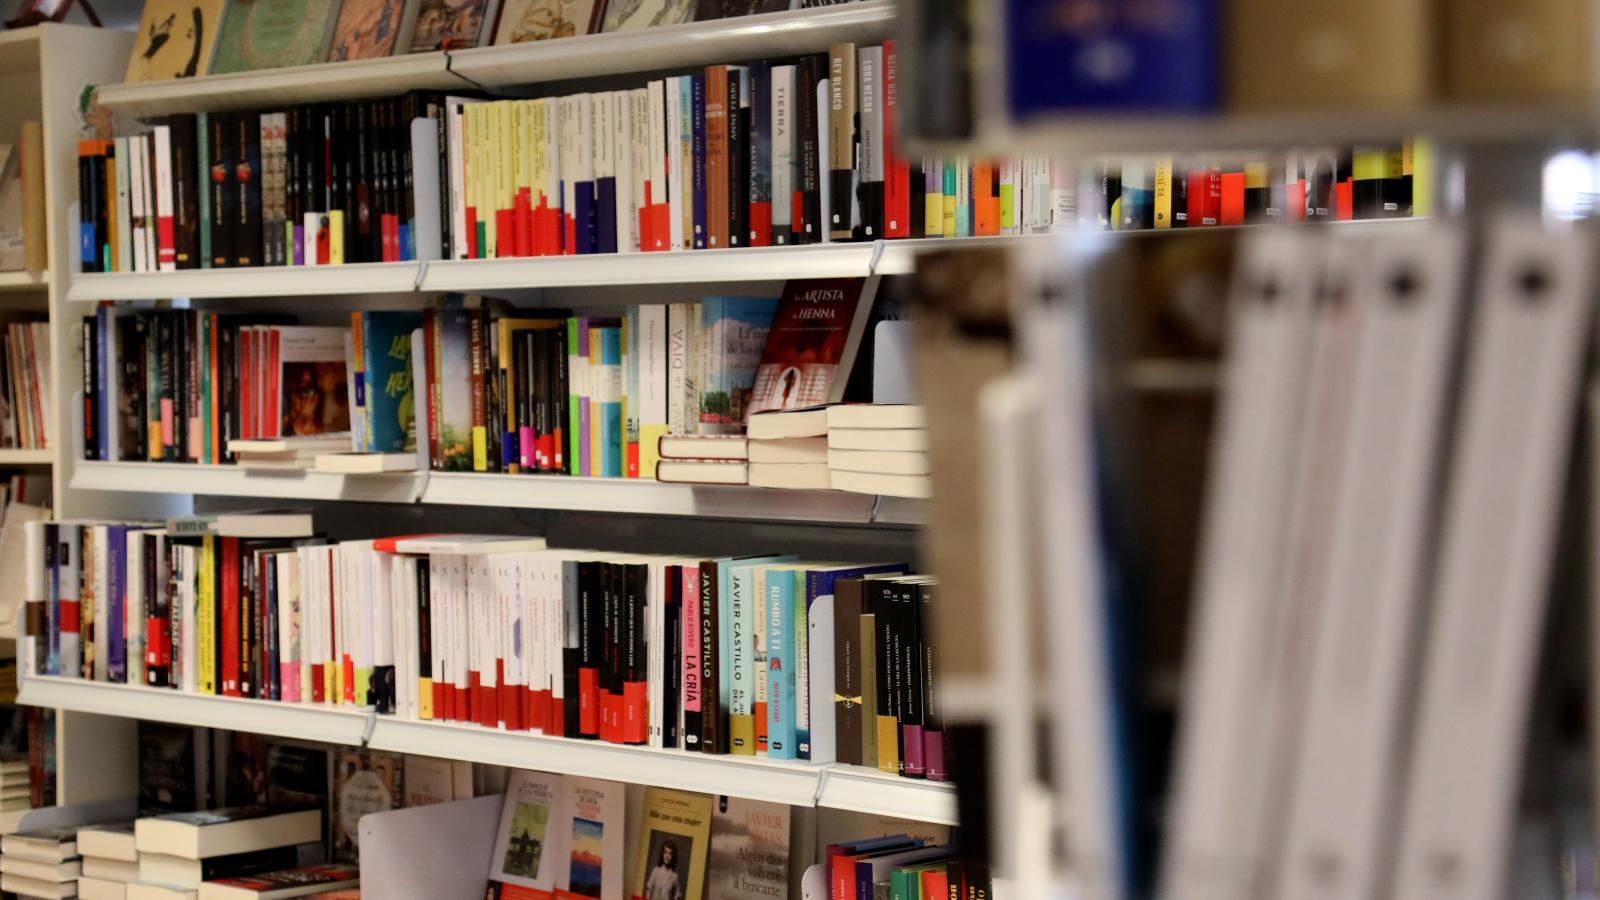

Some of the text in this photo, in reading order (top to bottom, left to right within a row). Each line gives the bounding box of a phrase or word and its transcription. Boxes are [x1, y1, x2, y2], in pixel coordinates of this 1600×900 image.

[729, 81, 737, 111] PERRY
[832, 57, 842, 110] REY BLANCO
[862, 60, 873, 113] LOBA NEGRA
[887, 55, 896, 106] REINA ROJA
[777, 86, 785, 136] TIERRA
[798, 308, 836, 320] HENNA
[802, 289, 844, 303] ARTISTA
[672, 329, 683, 369] DIVA
[727, 342, 754, 354] de los
[738, 327, 750, 339] La
[674, 376, 682, 389] LA
[687, 600, 695, 648] PABLO RIVERO
[702, 572, 711, 678] JAVIER CASTILLO
[733, 576, 742, 681] JAVIER CASTILLO
[770, 586, 781, 650] RUMBO A TI
[685, 655, 699, 702] LA CRÍA
[739, 690, 744, 700] EL
[745, 812, 782, 830] JAVIER
[742, 878, 781, 897] buscarte
